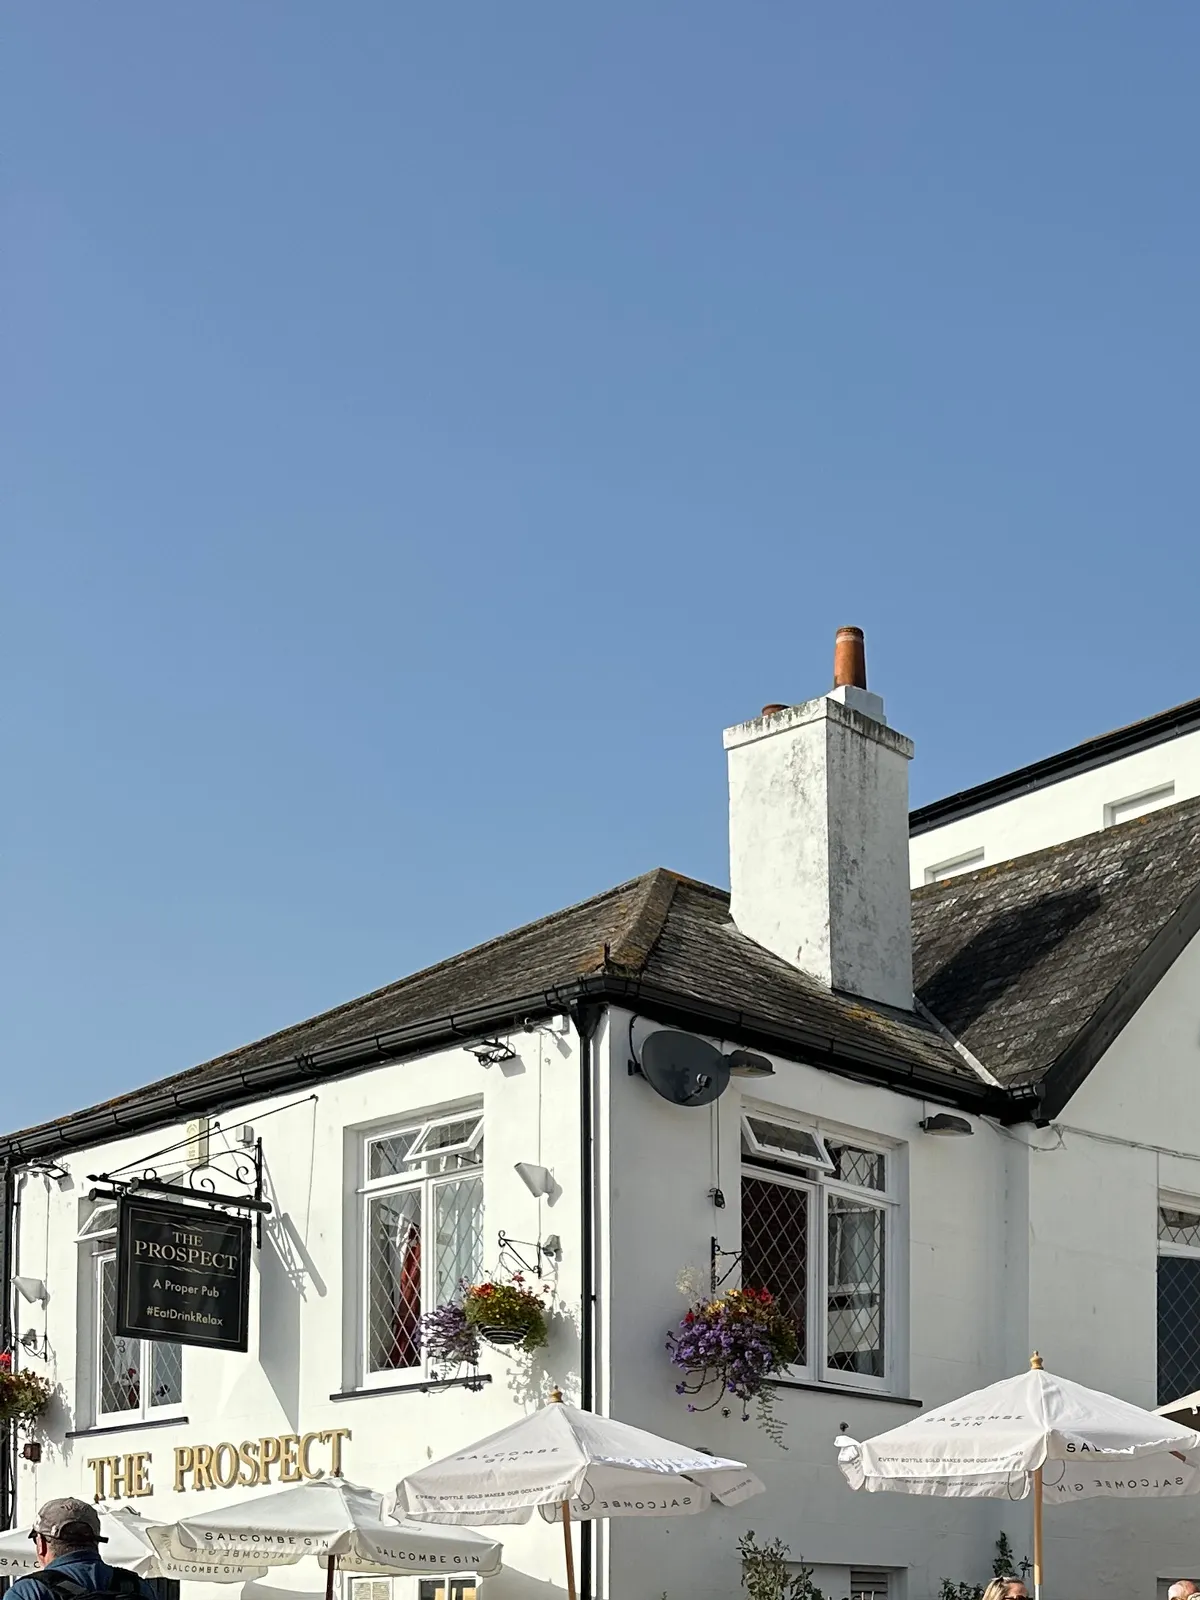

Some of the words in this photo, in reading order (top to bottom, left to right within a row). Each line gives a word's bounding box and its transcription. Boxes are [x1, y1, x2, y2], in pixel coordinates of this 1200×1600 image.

[172, 1231, 203, 1247] THE
[134, 1240, 238, 1270] PROSPECT
[153, 1279, 162, 1289] A
[165, 1282, 199, 1295] Proper
[201, 1286, 220, 1298] Pub
[146, 1305, 223, 1326] #EatDrinkRelax
[925, 1414, 1026, 1423] SALCOMBE
[456, 1447, 560, 1461] SALCOMBE
[485, 1456, 519, 1464] GIN
[87, 1452, 154, 1500] THE
[173, 1428, 353, 1492] PROSPECT
[204, 1532, 296, 1544] SALCOMBE
[304, 1538, 330, 1548] GIN
[376, 1547, 447, 1564] SALCOMBE
[453, 1555, 480, 1564] GIN
[167, 1564, 219, 1574] SALCOMBE
[224, 1566, 244, 1574] GIN
